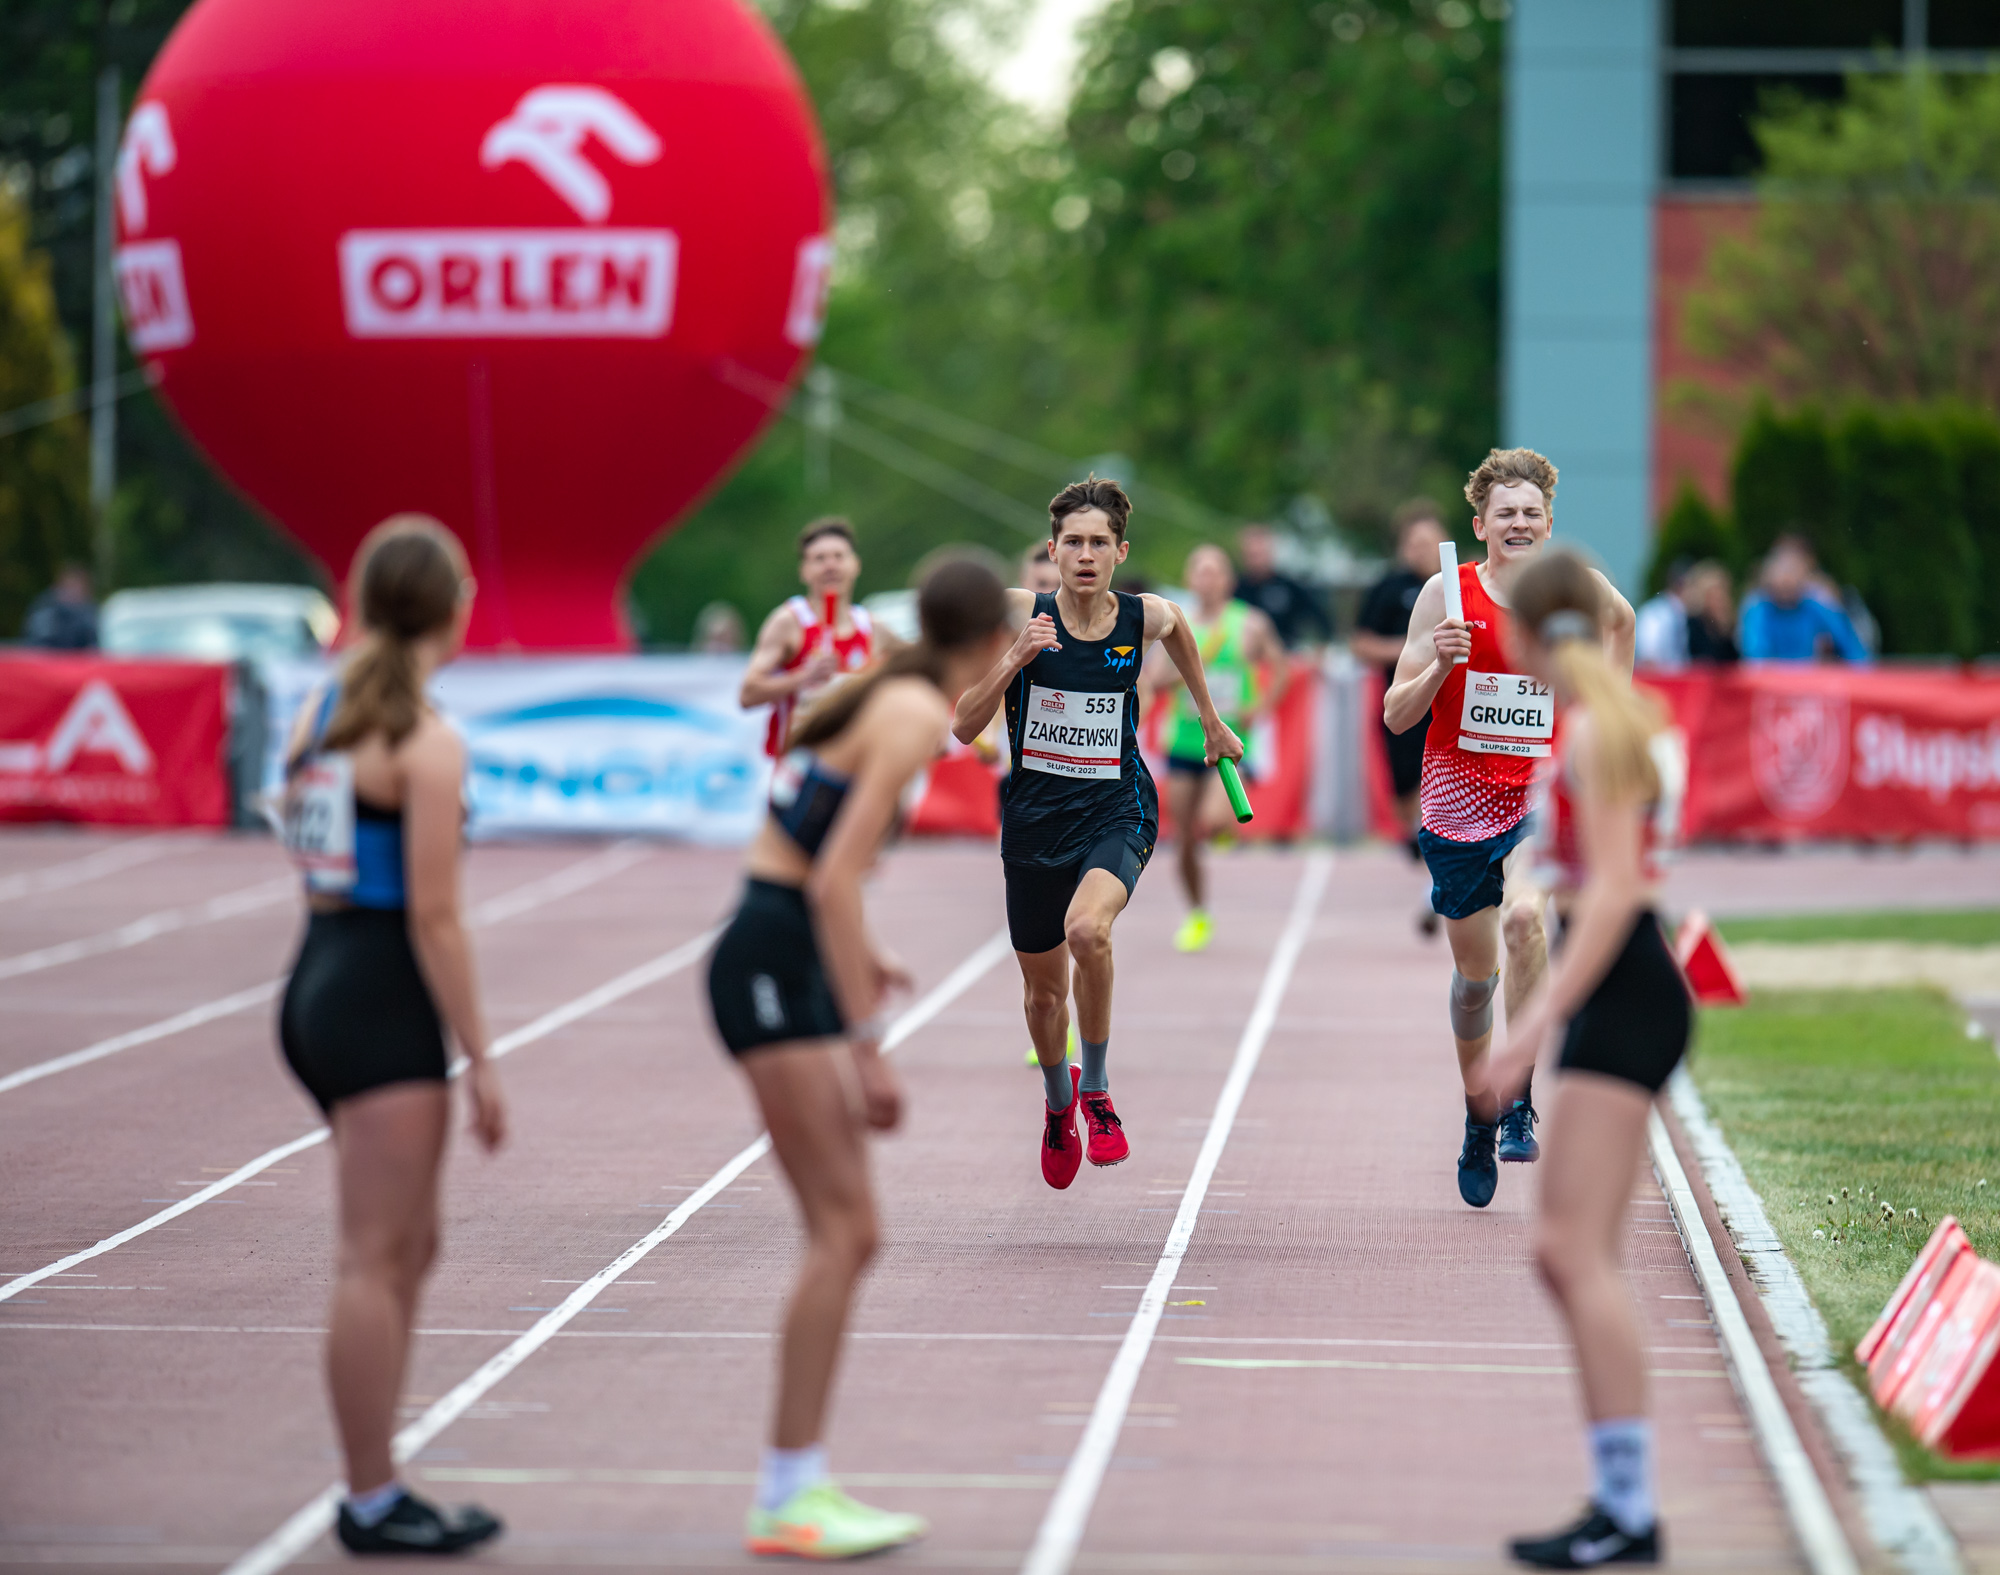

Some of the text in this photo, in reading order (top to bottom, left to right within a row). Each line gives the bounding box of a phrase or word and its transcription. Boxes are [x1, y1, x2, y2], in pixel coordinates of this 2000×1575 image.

[367, 254, 649, 314] ORLEN
[1104, 648, 1136, 674] Sopot
[1476, 684, 1498, 692] ORLEN
[1517, 680, 1549, 696] 512
[1040, 707, 1064, 715] FUNDACJA
[1042, 700, 1064, 709] ORLEN
[1085, 698, 1116, 714] 553
[1470, 705, 1545, 727] GRUGEL
[1028, 720, 1118, 747] ZAKRZEWSKI
[1480, 743, 1531, 753] SŁUPSK 2023
[1046, 762, 1076, 773] SŁUPSK
